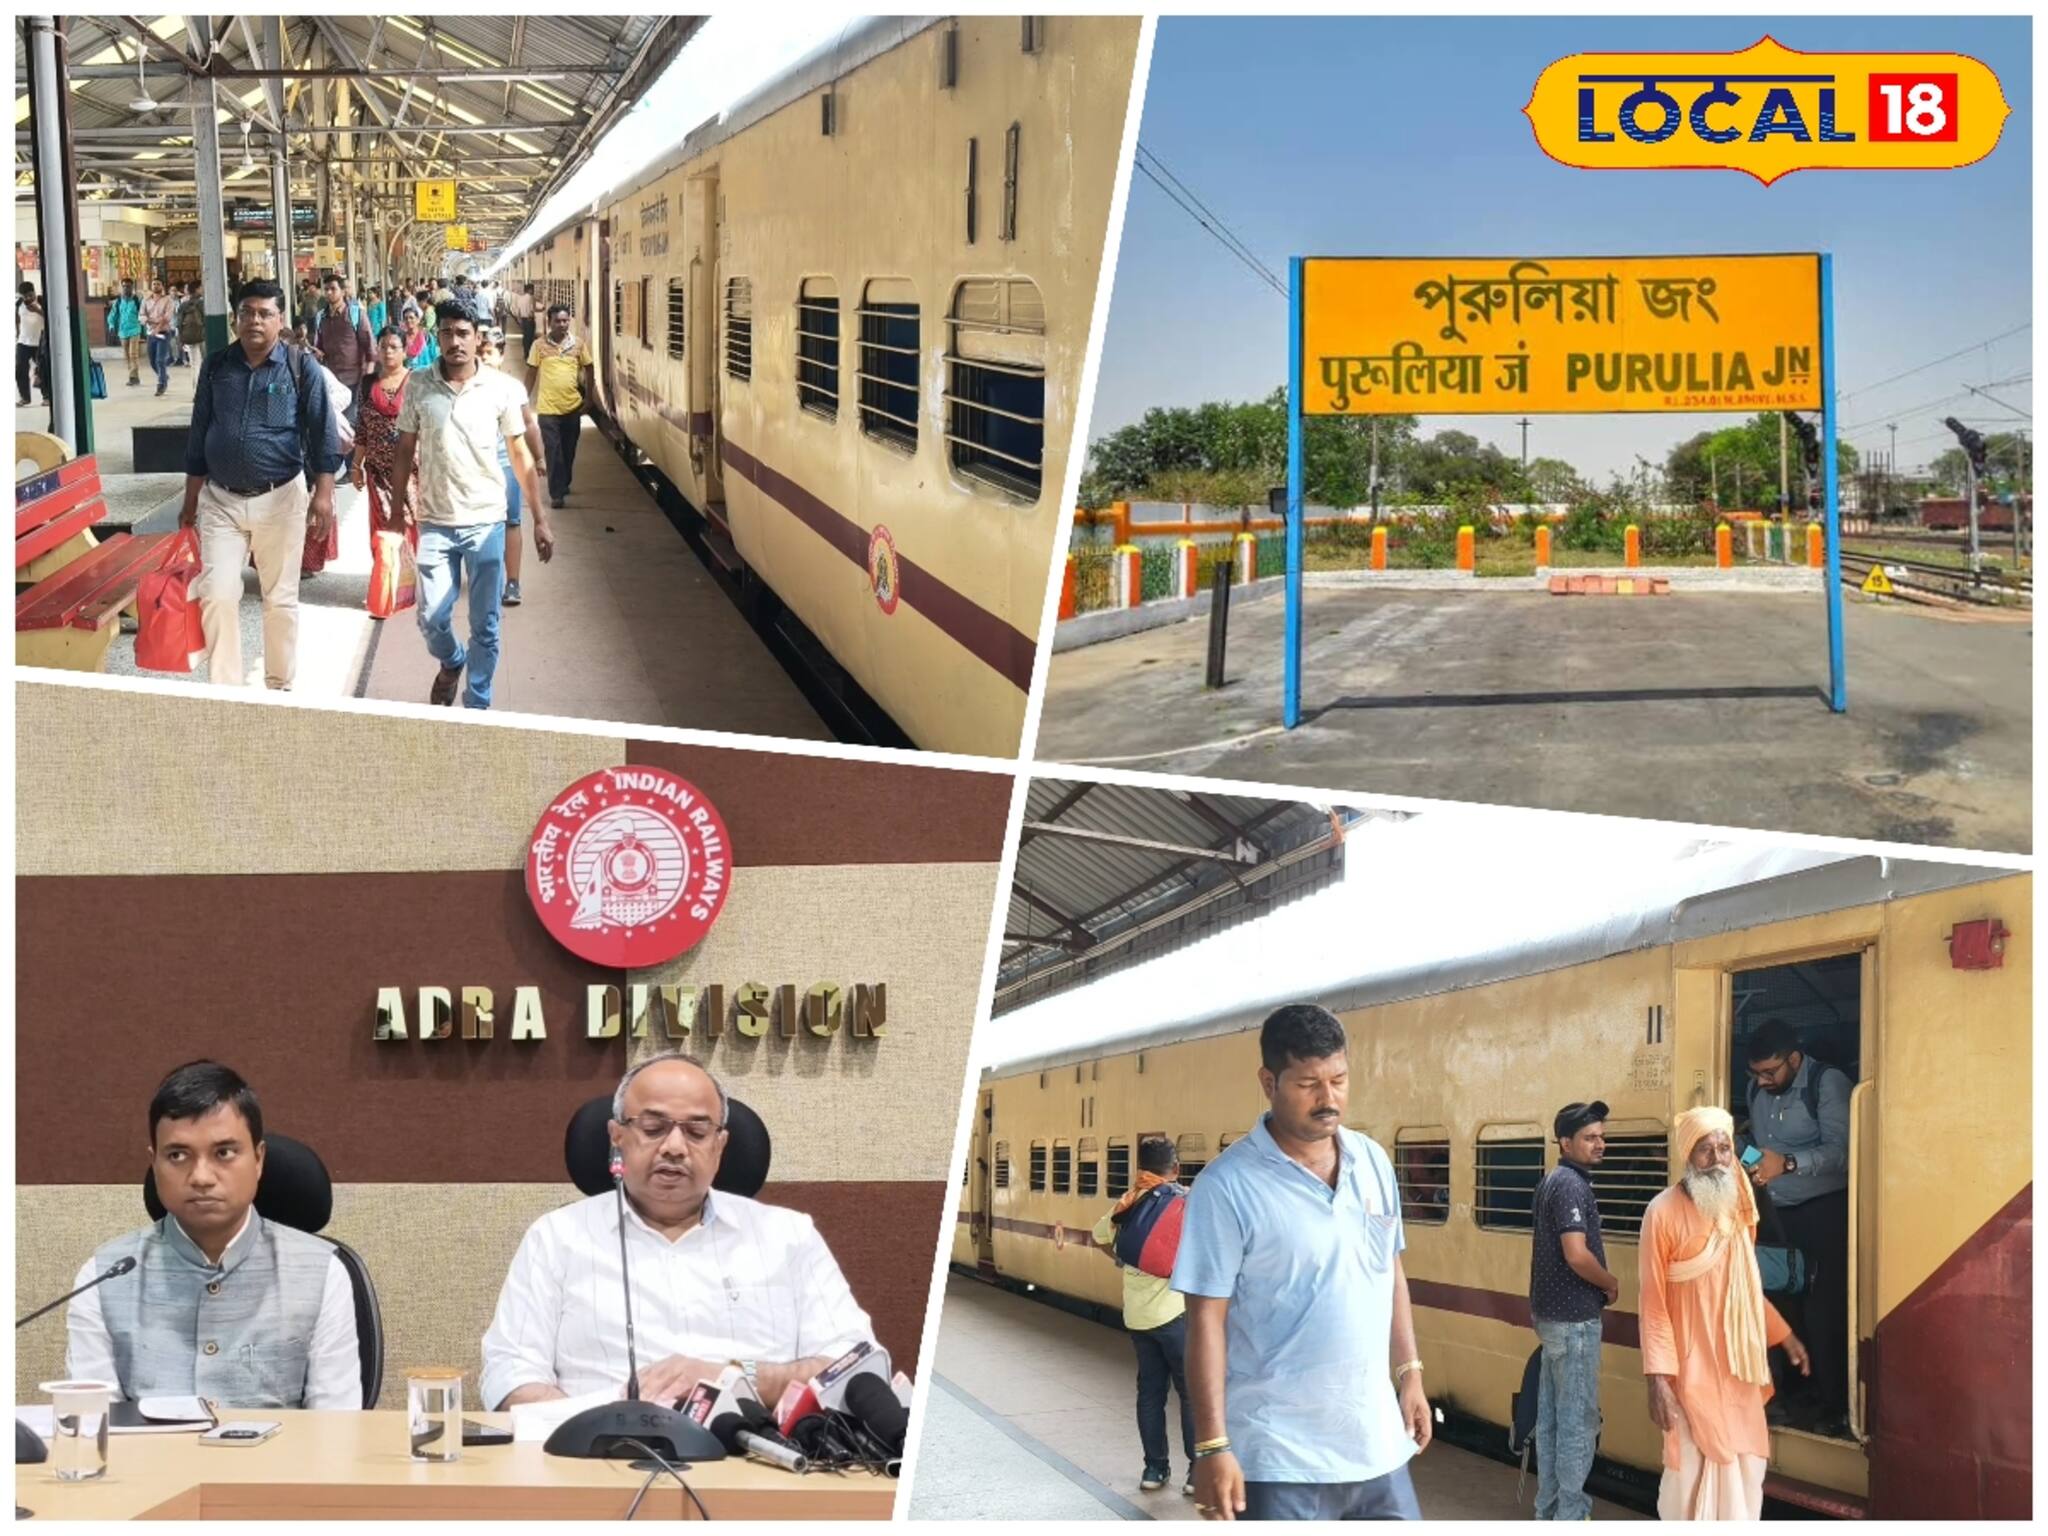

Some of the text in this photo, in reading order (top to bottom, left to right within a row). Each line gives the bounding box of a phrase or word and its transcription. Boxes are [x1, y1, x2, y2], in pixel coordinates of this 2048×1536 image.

[1414, 261, 1719, 344] পুরুলিয়া জং
[1494, 339, 1530, 393] जं
[1567, 352, 1755, 393] PURULIA
[532, 790, 589, 904] भारतीय रेल
[614, 772, 725, 921] INDIAN RAILWAYS
[373, 982, 887, 1041] ADRA DIVISION
